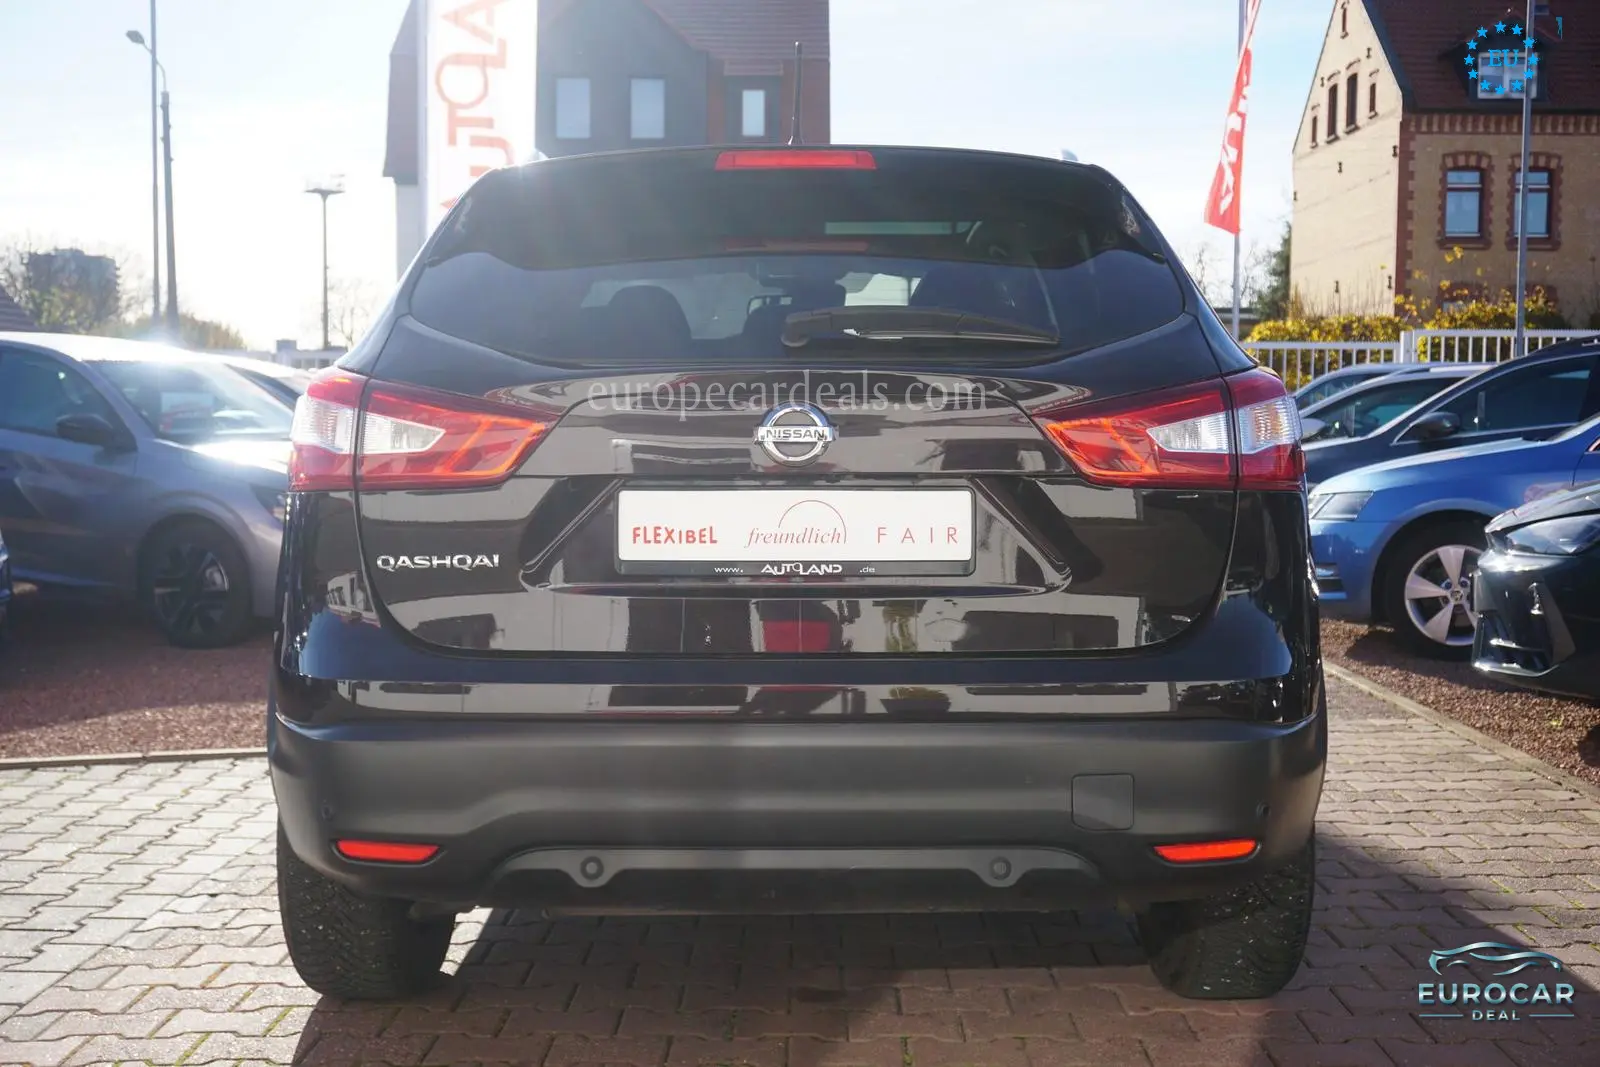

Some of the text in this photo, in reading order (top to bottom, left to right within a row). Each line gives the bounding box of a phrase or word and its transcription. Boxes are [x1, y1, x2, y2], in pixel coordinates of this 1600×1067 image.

[435, 0, 515, 211] UTOLA
[766, 429, 825, 439] NISSAN
[632, 526, 958, 548] FLEXIBEL freundlich FAIR
[376, 554, 500, 572] QASHQAI
[714, 566, 744, 574] www.
[760, 561, 843, 576] AUTOLAND
